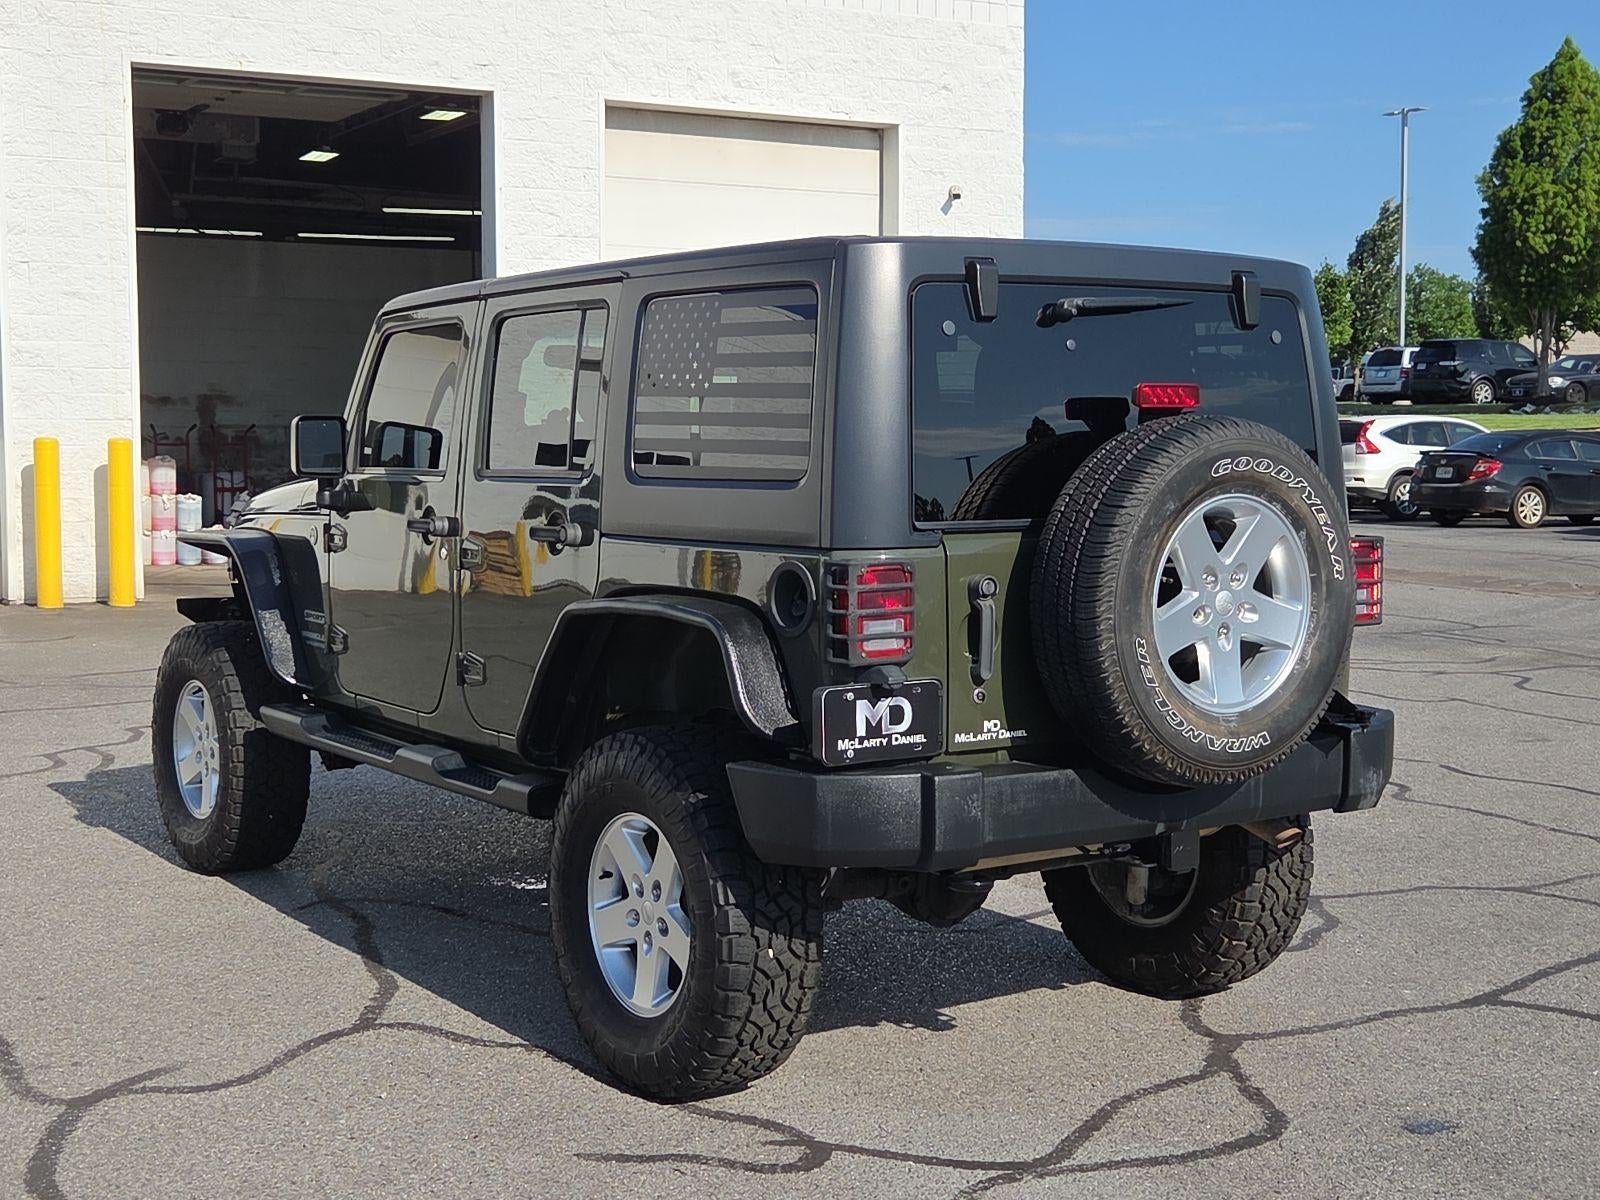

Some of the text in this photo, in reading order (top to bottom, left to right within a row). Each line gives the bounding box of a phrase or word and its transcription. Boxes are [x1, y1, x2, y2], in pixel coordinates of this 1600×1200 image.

[1211, 456, 1345, 581] GOODYEAR
[1135, 637, 1271, 753] WRANGLER
[855, 696, 913, 737] MD
[983, 720, 1001, 733] MD
[891, 733, 927, 746] DANIEL
[998, 729, 1028, 739] DANIEL
